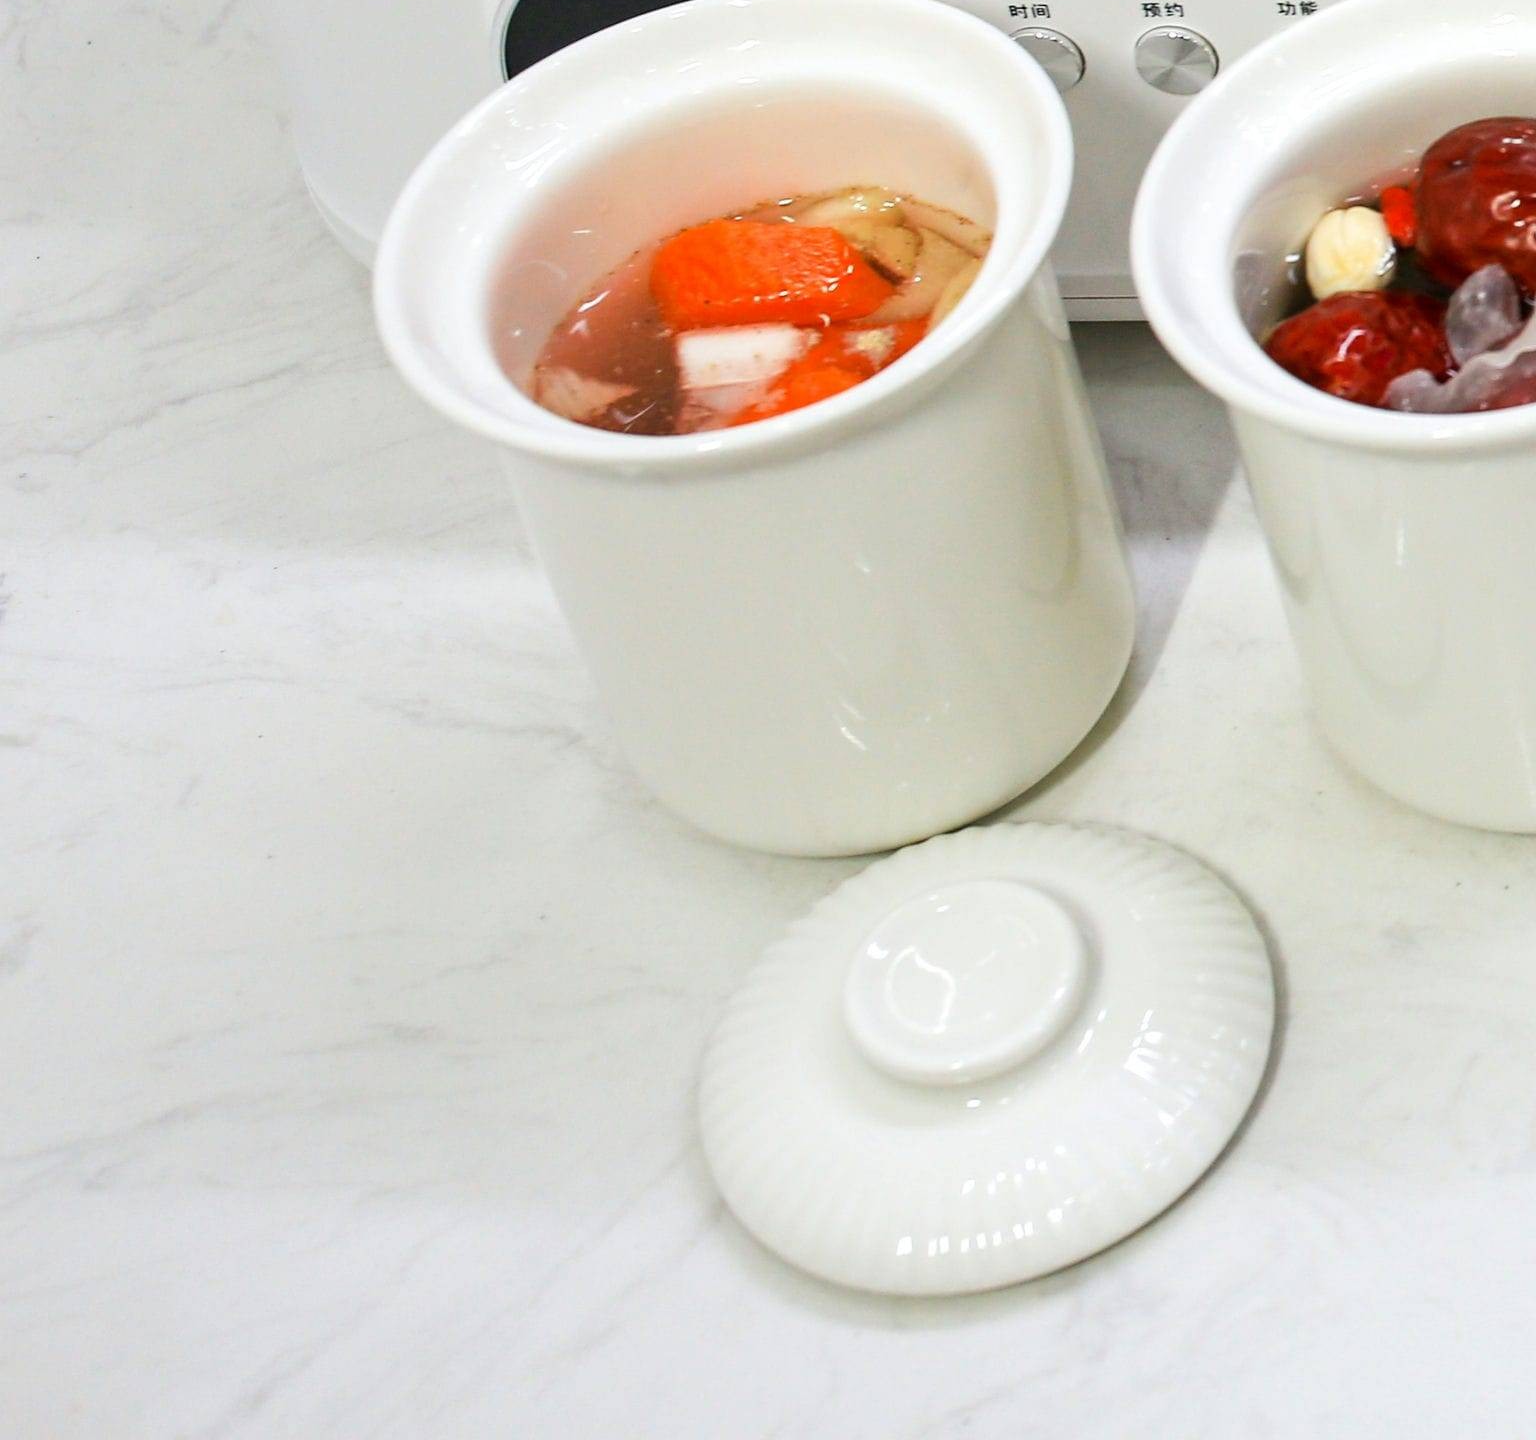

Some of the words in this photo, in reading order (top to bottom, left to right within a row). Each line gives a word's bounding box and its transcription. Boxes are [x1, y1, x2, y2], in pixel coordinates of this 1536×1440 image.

[1008, 3, 1051, 19] 时间
[1141, 2, 1185, 18] 预约
[1276, 1, 1319, 17] 功能
